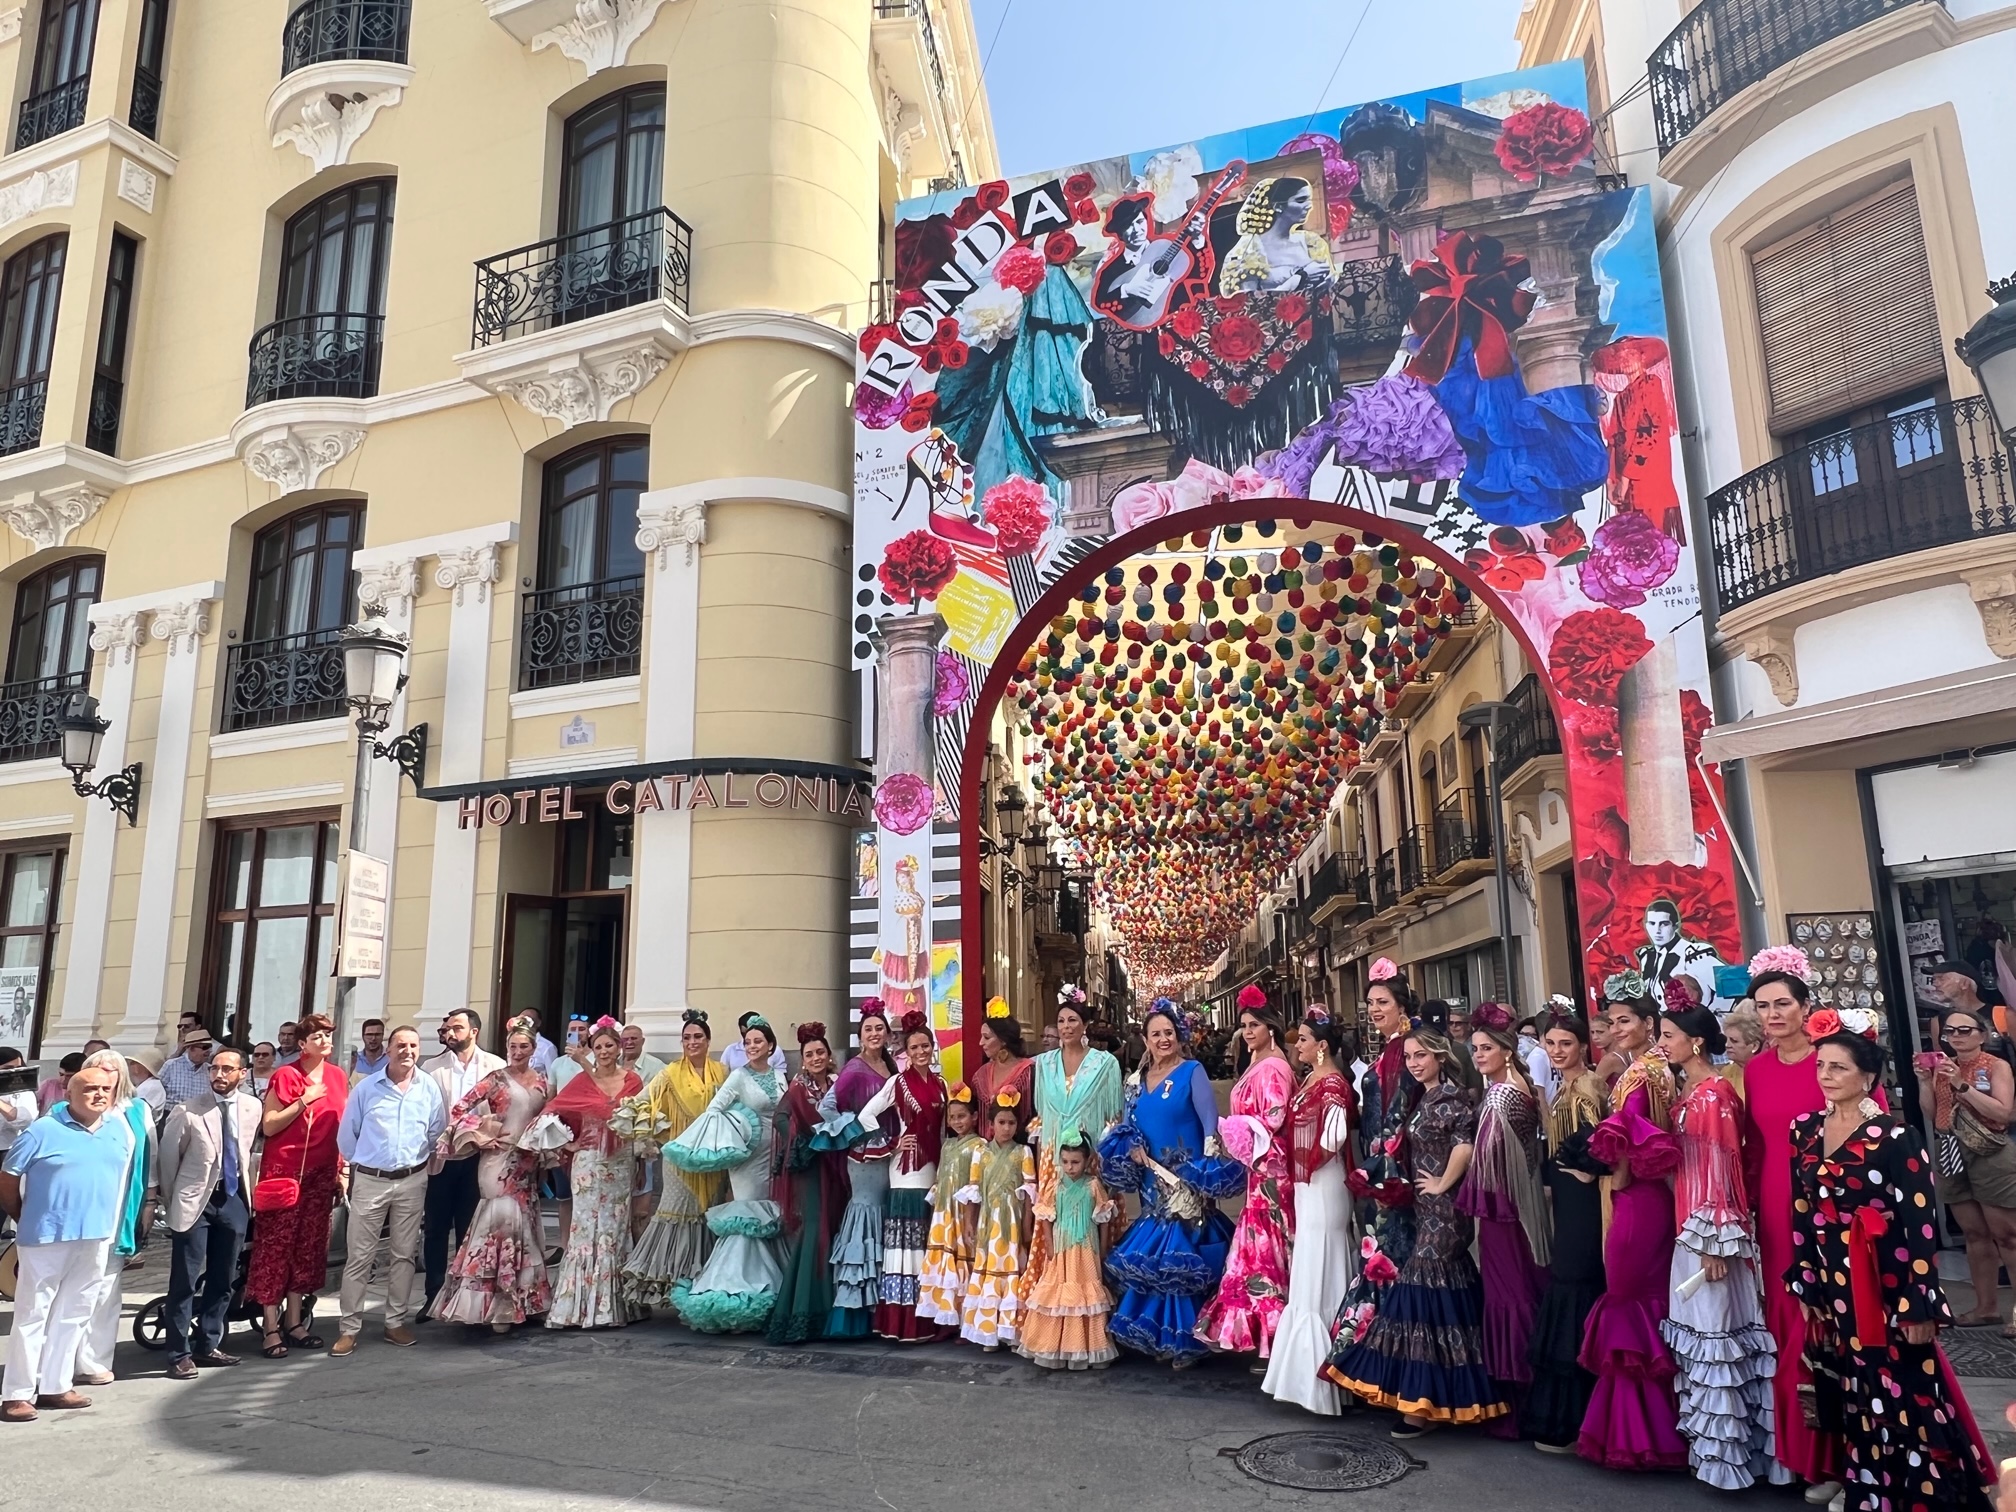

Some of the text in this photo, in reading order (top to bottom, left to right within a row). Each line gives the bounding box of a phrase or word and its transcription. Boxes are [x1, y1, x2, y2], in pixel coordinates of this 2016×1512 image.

[863, 189, 1068, 395] RONDA
[875, 447, 883, 458] 2
[1651, 586, 1682, 597] GRADA
[457, 772, 867, 830] HOTEL CATALONIA
[1905, 932, 1931, 944] ONDA
